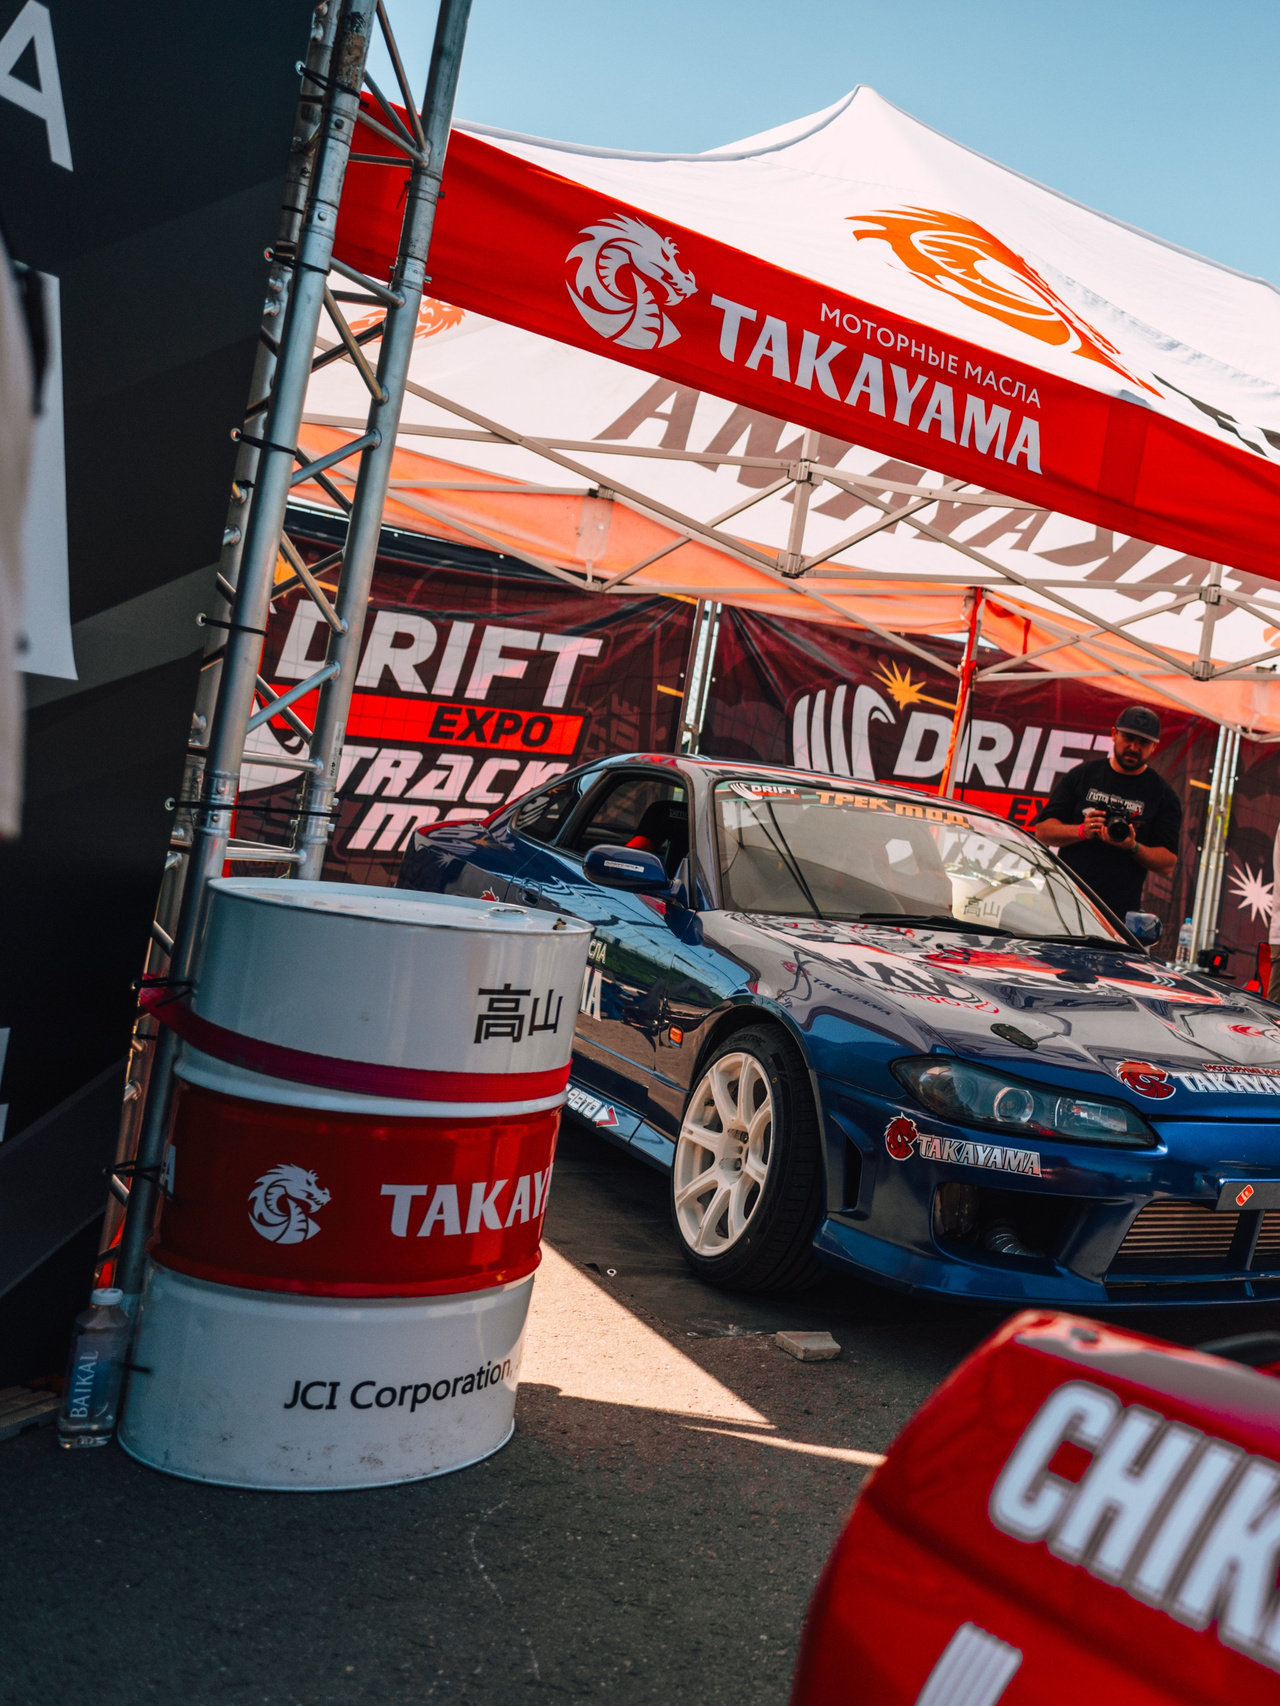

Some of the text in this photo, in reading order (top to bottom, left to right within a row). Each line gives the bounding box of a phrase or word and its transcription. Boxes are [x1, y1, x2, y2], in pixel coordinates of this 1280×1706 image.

[711, 294, 1042, 475] TAKAYAMA
[820, 303, 1041, 409] МОТОРНЫЕ МАСЛА
[275, 600, 603, 708] DRIFT
[428, 706, 554, 747] EXPO
[751, 785, 797, 795] DRIFT
[473, 983, 564, 1044] 高山
[917, 1133, 1042, 1177] TAKAYAMA
[380, 1162, 553, 1238] TAKAY
[70, 1351, 98, 1417] BAIKAL
[284, 1380, 340, 1410] JCI
